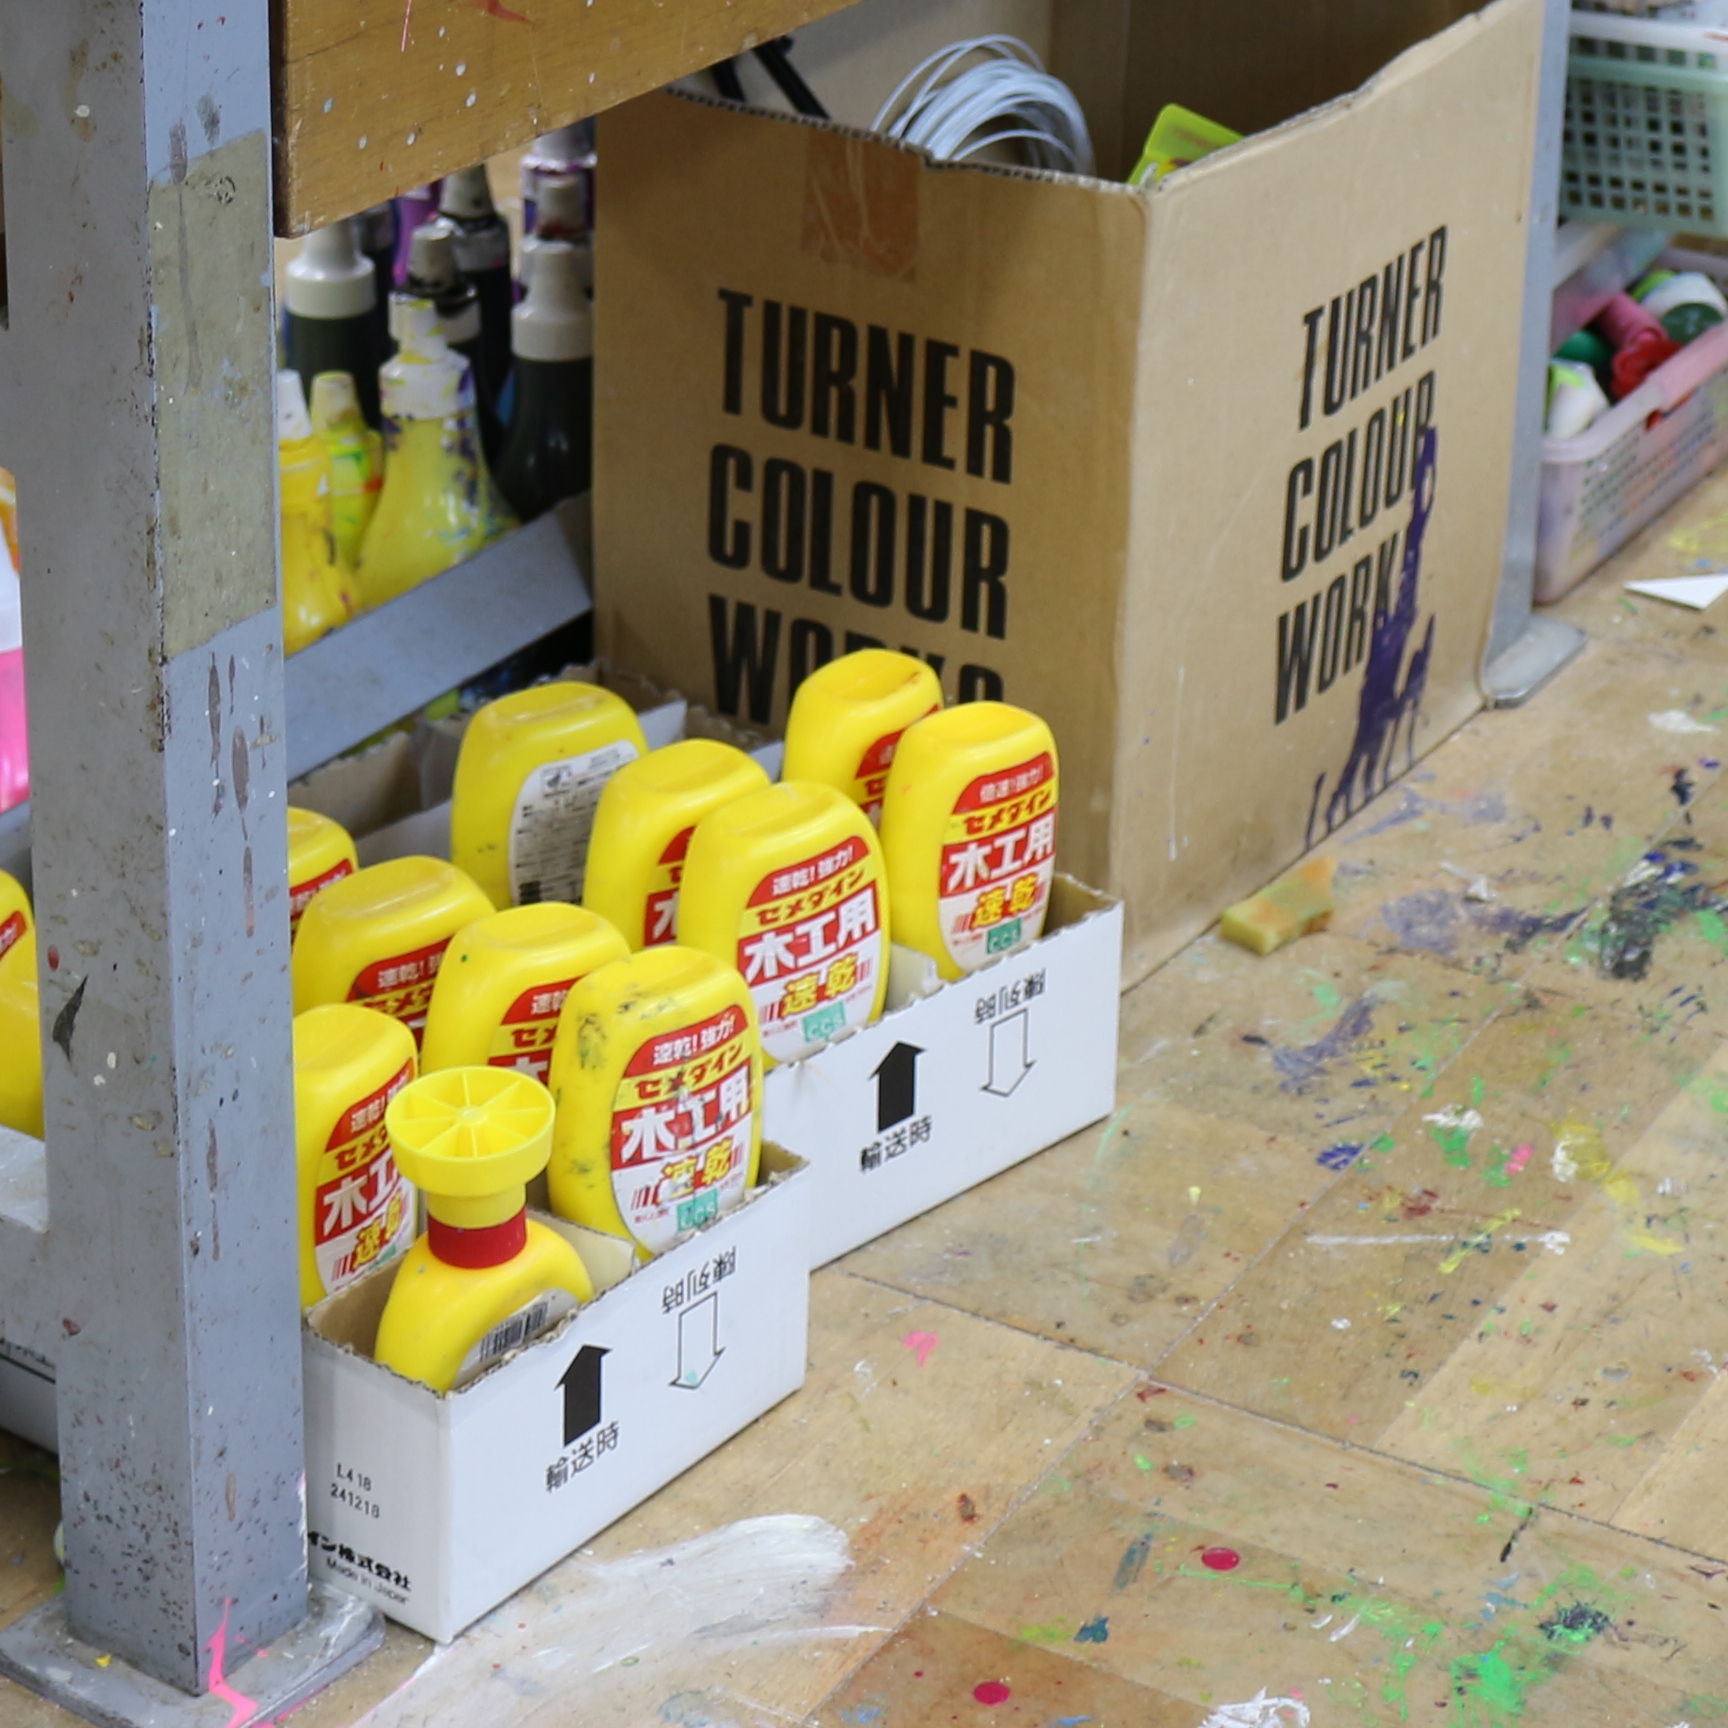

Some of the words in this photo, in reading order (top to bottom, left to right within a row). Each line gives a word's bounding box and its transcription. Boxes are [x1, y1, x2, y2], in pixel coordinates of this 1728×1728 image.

[1300, 225, 1448, 431] TURNER
[718, 288, 1015, 485] TURNER
[1282, 370, 1435, 583] COLOUR
[708, 443, 1009, 640] COLOUR
[1276, 530, 1410, 725] WORK
[947, 811, 1054, 893] 木工用
[963, 788, 1052, 836] セメダイン
[743, 886, 877, 983] 木工用
[756, 868, 865, 925] セメダイン
[973, 872, 1038, 928] 速乾
[782, 952, 858, 1017] 速乾
[622, 1064, 749, 1163] 木工用
[859, 1115, 932, 1174] 輸送時
[323, 1153, 400, 1238] 木工
[545, 1420, 620, 1493] 輸送時
